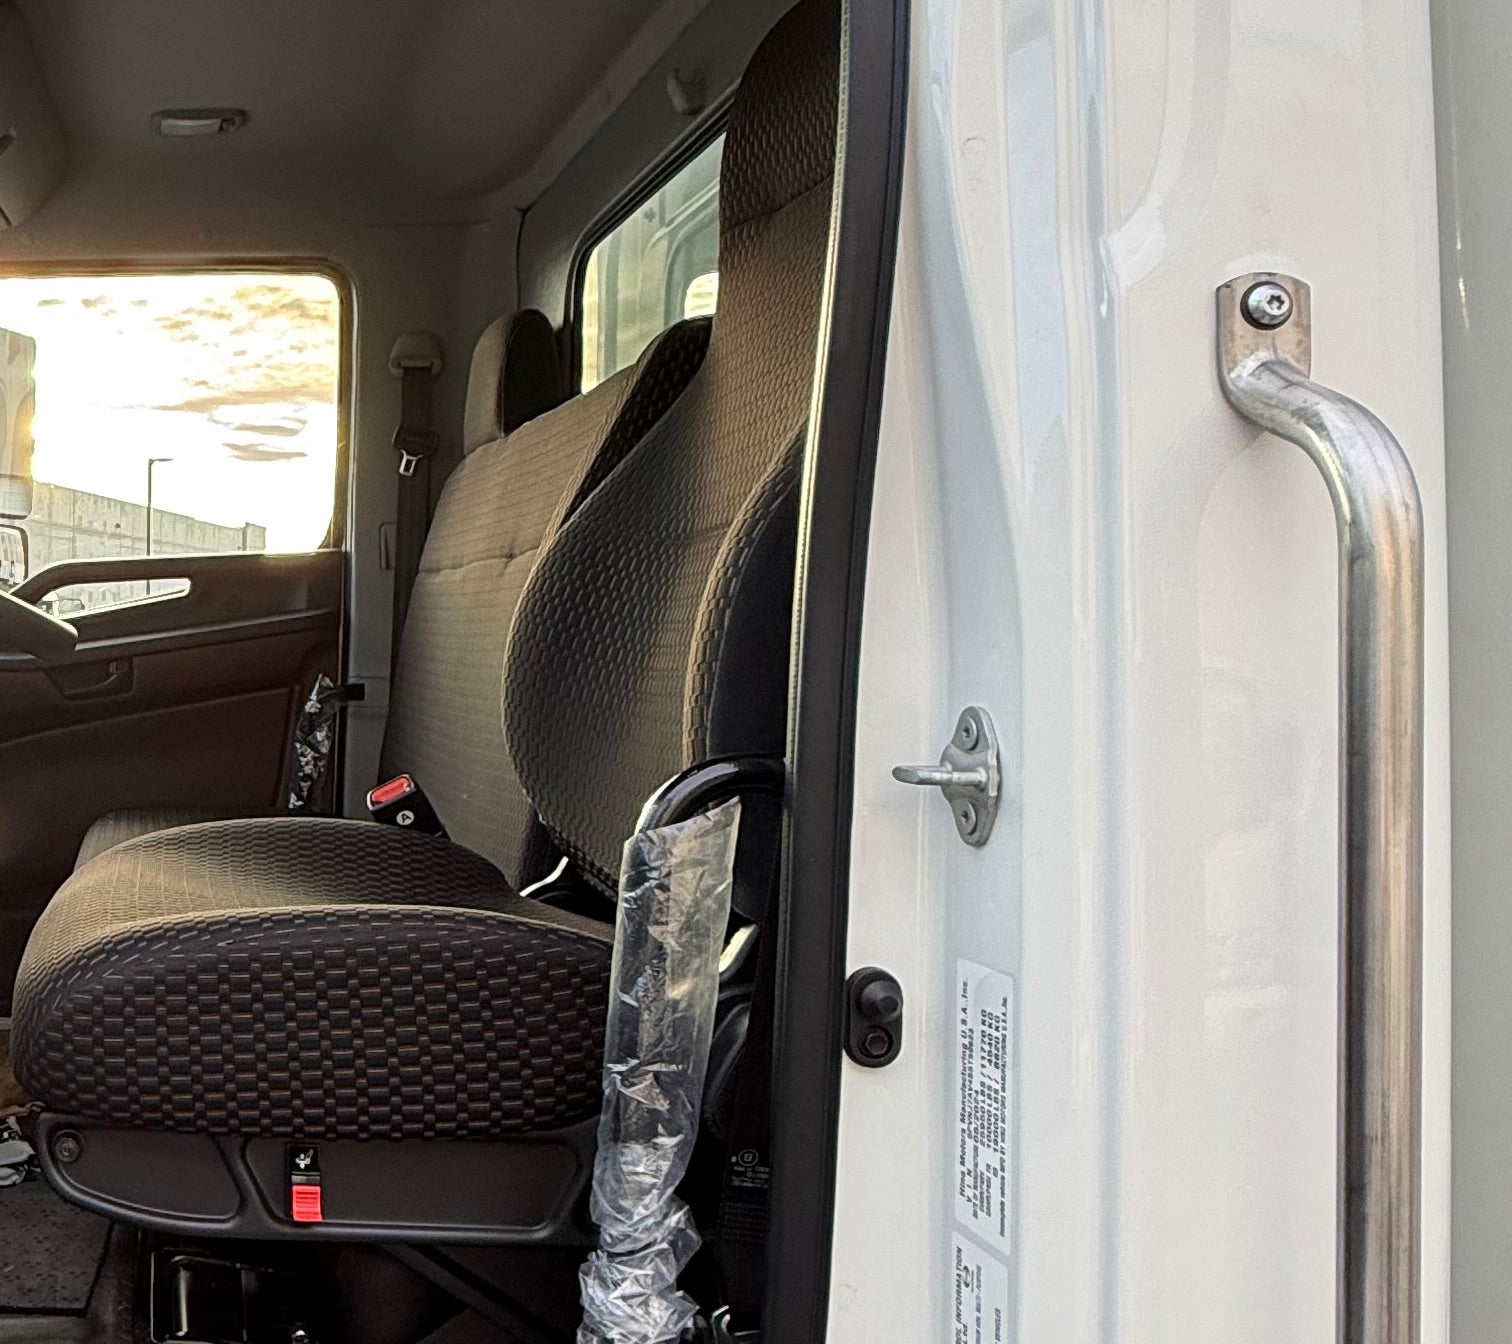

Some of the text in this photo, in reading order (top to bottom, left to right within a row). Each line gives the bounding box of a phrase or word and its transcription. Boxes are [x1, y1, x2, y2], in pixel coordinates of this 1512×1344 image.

[981, 1009, 986, 1026] KG
[988, 1011, 993, 1029] KG
[994, 1014, 1000, 1033] KG
[960, 1042, 969, 1124] Manufacturing
